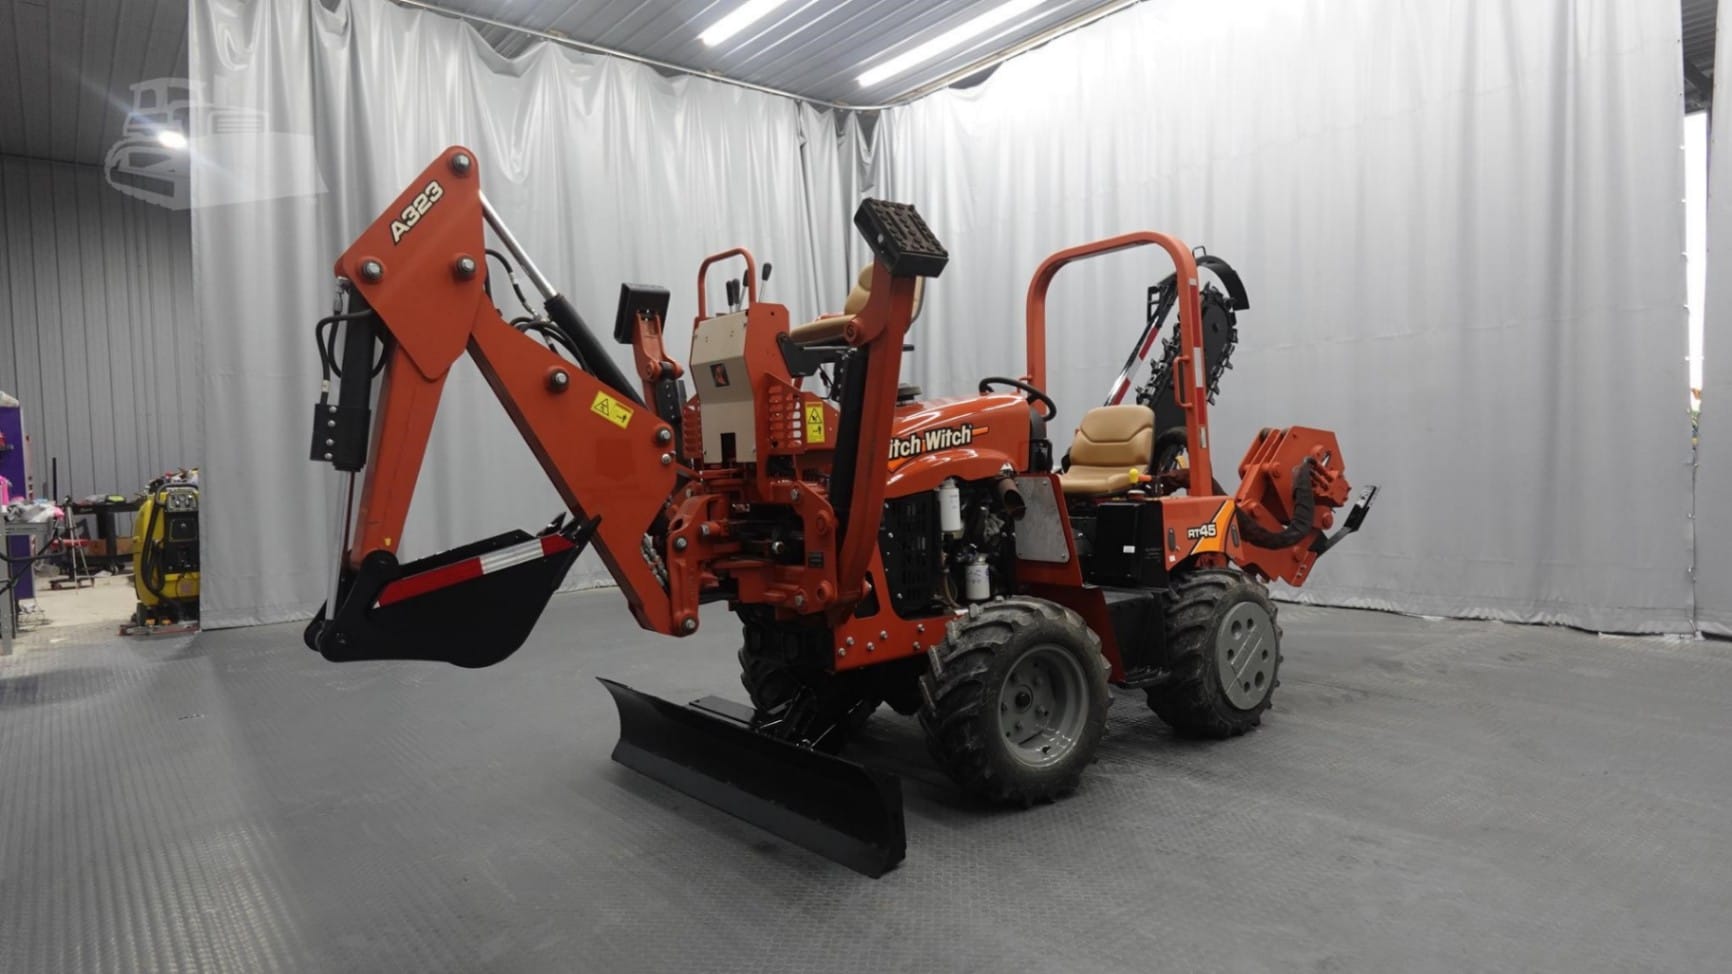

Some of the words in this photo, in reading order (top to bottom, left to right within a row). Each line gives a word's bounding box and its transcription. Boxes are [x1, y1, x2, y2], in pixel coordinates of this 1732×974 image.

[390, 180, 444, 245] A323
[888, 434, 921, 459] itch
[925, 424, 971, 450] Witch
